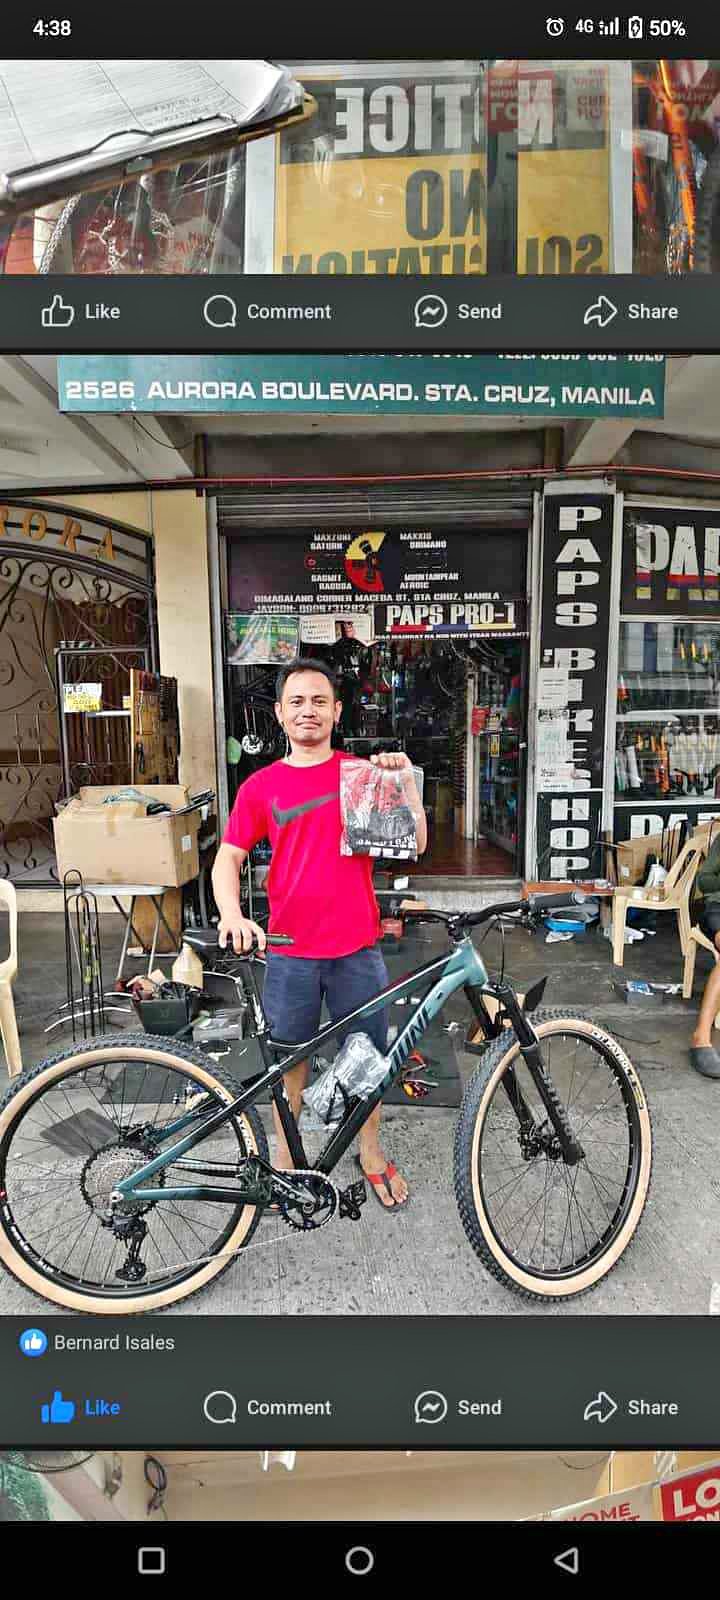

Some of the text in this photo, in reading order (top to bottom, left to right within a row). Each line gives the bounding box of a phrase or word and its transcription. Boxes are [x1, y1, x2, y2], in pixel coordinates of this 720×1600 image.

[66, 381, 135, 399] 2526
[147, 381, 256, 399] AURORA
[425, 384, 478, 402] STA.
[484, 384, 556, 407] CRUZ,
[561, 386, 656, 406] MANILA
[555, 506, 602, 627] PAPS
[386, 603, 443, 626] PAPS
